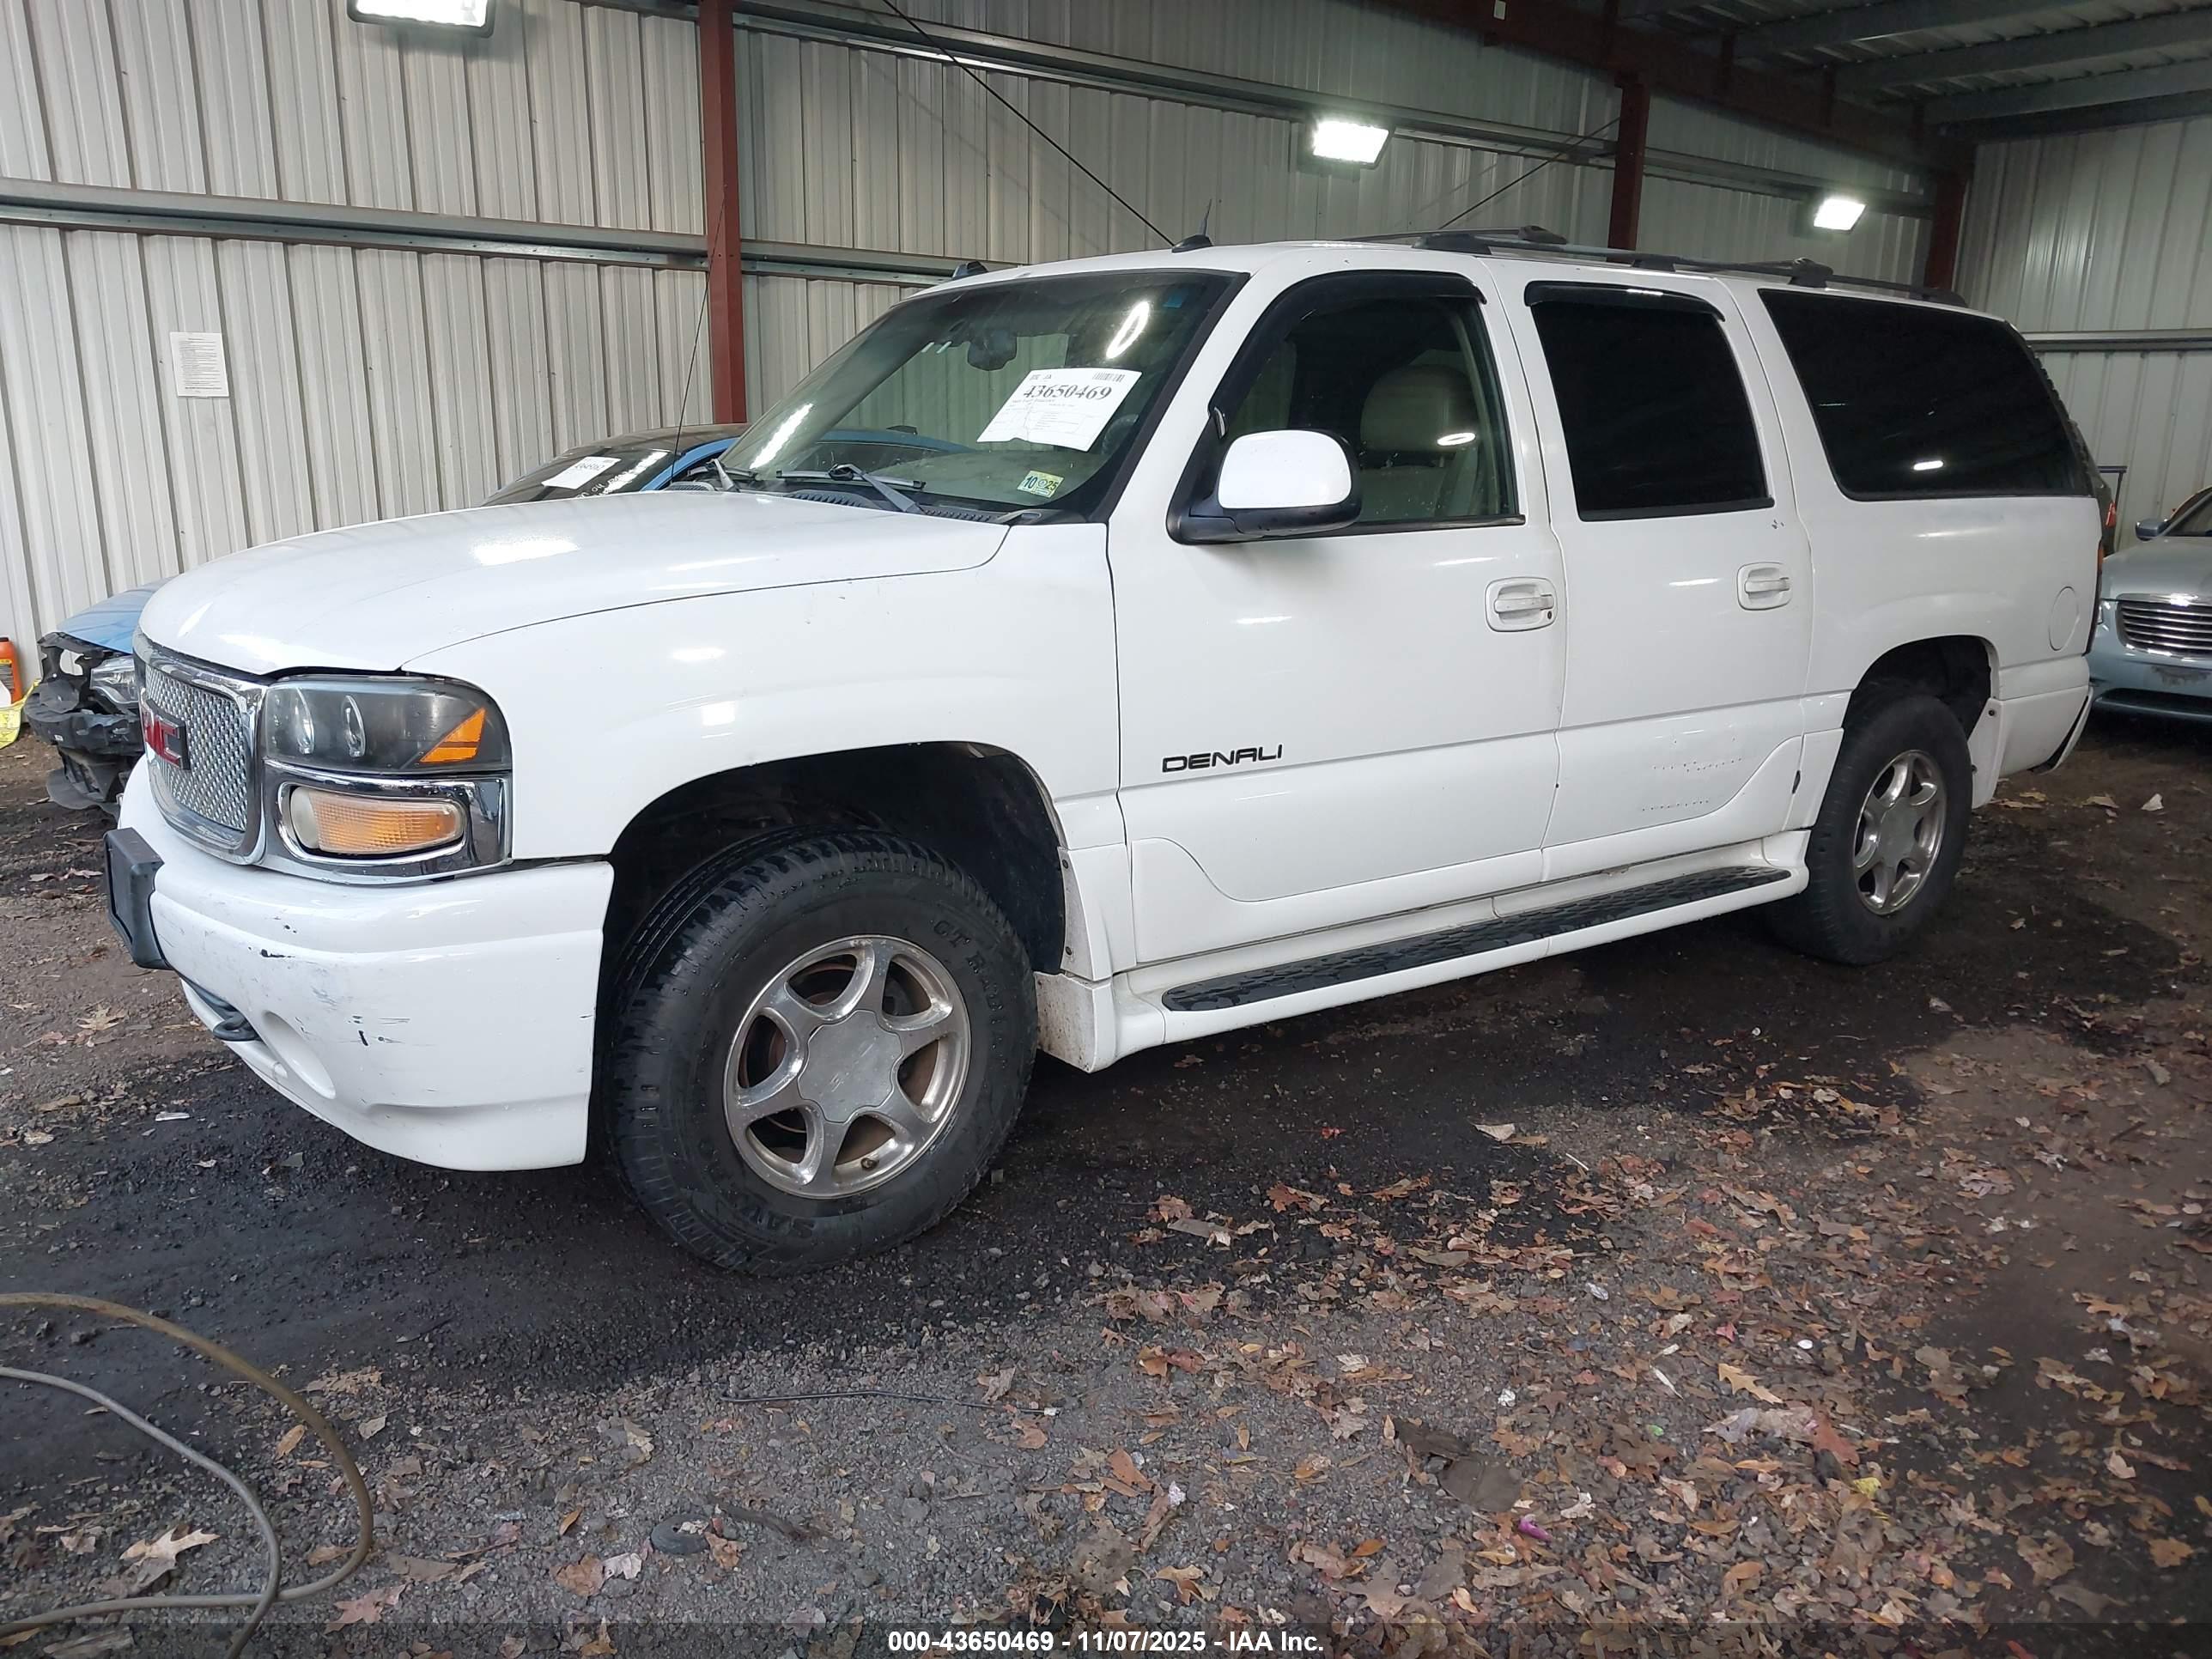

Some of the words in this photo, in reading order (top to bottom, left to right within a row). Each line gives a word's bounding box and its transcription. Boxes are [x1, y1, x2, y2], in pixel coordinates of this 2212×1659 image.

[1023, 384, 1113, 401] 43650469
[1024, 476, 1038, 489] 10
[1045, 480, 1058, 491] 25
[1162, 744, 1283, 773] DENALI
